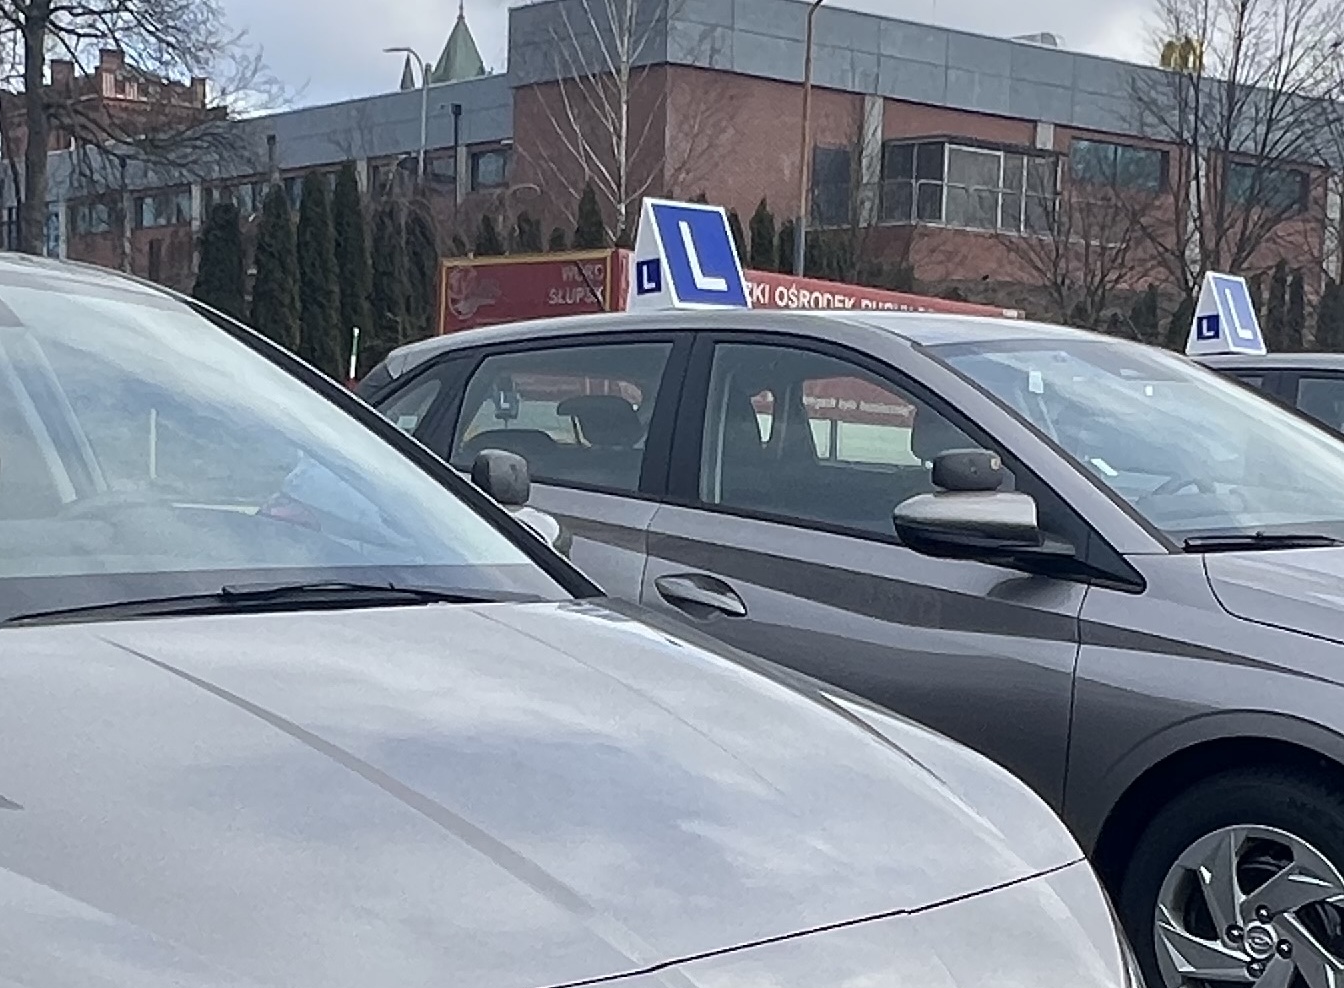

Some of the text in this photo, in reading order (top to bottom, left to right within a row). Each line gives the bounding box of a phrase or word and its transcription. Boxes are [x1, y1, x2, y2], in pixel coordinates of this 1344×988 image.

[678, 220, 728, 291] L
[642, 265, 656, 290] L
[1202, 318, 1216, 337] L
[1224, 288, 1254, 340] L
